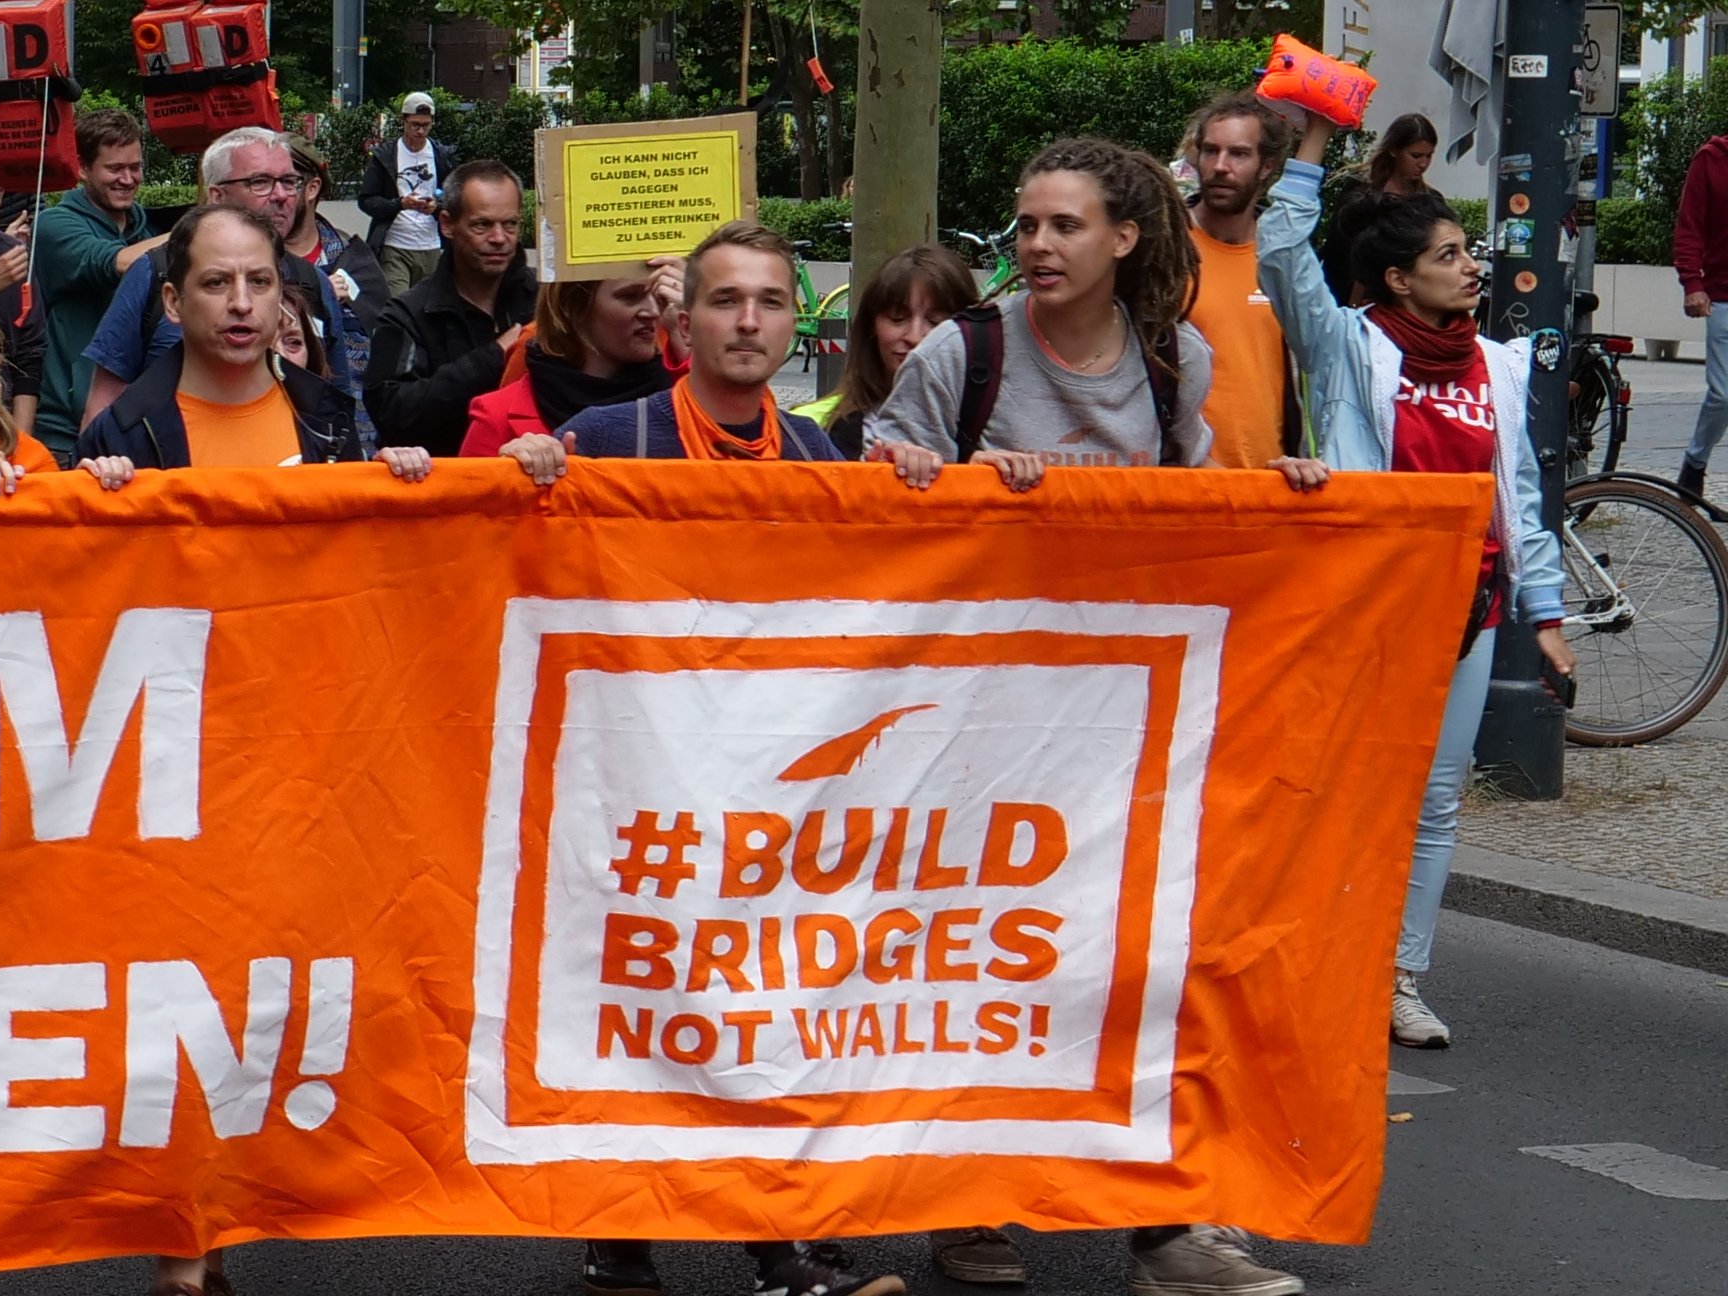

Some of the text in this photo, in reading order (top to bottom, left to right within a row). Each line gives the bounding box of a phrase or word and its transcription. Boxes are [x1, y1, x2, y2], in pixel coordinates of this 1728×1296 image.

[13, 24, 49, 70] D
[224, 25, 250, 59] D
[150, 54, 166, 76] 4
[153, 103, 201, 119] EUROPA
[600, 151, 699, 165] ICH KANN NICHT
[590, 166, 709, 181] GLAUBEN, DASS ICH
[621, 184, 678, 195] DAGEGEN
[586, 198, 716, 213] PROTESTIEREN MUSS,
[582, 213, 720, 229] MENSCHEN ERTRINKEN
[616, 230, 686, 243] ZU LASSEN.
[609, 802, 1071, 899] #BUILD
[599, 907, 1066, 993] BRIDGES
[596, 1000, 1051, 1066] NOT WALLS!
